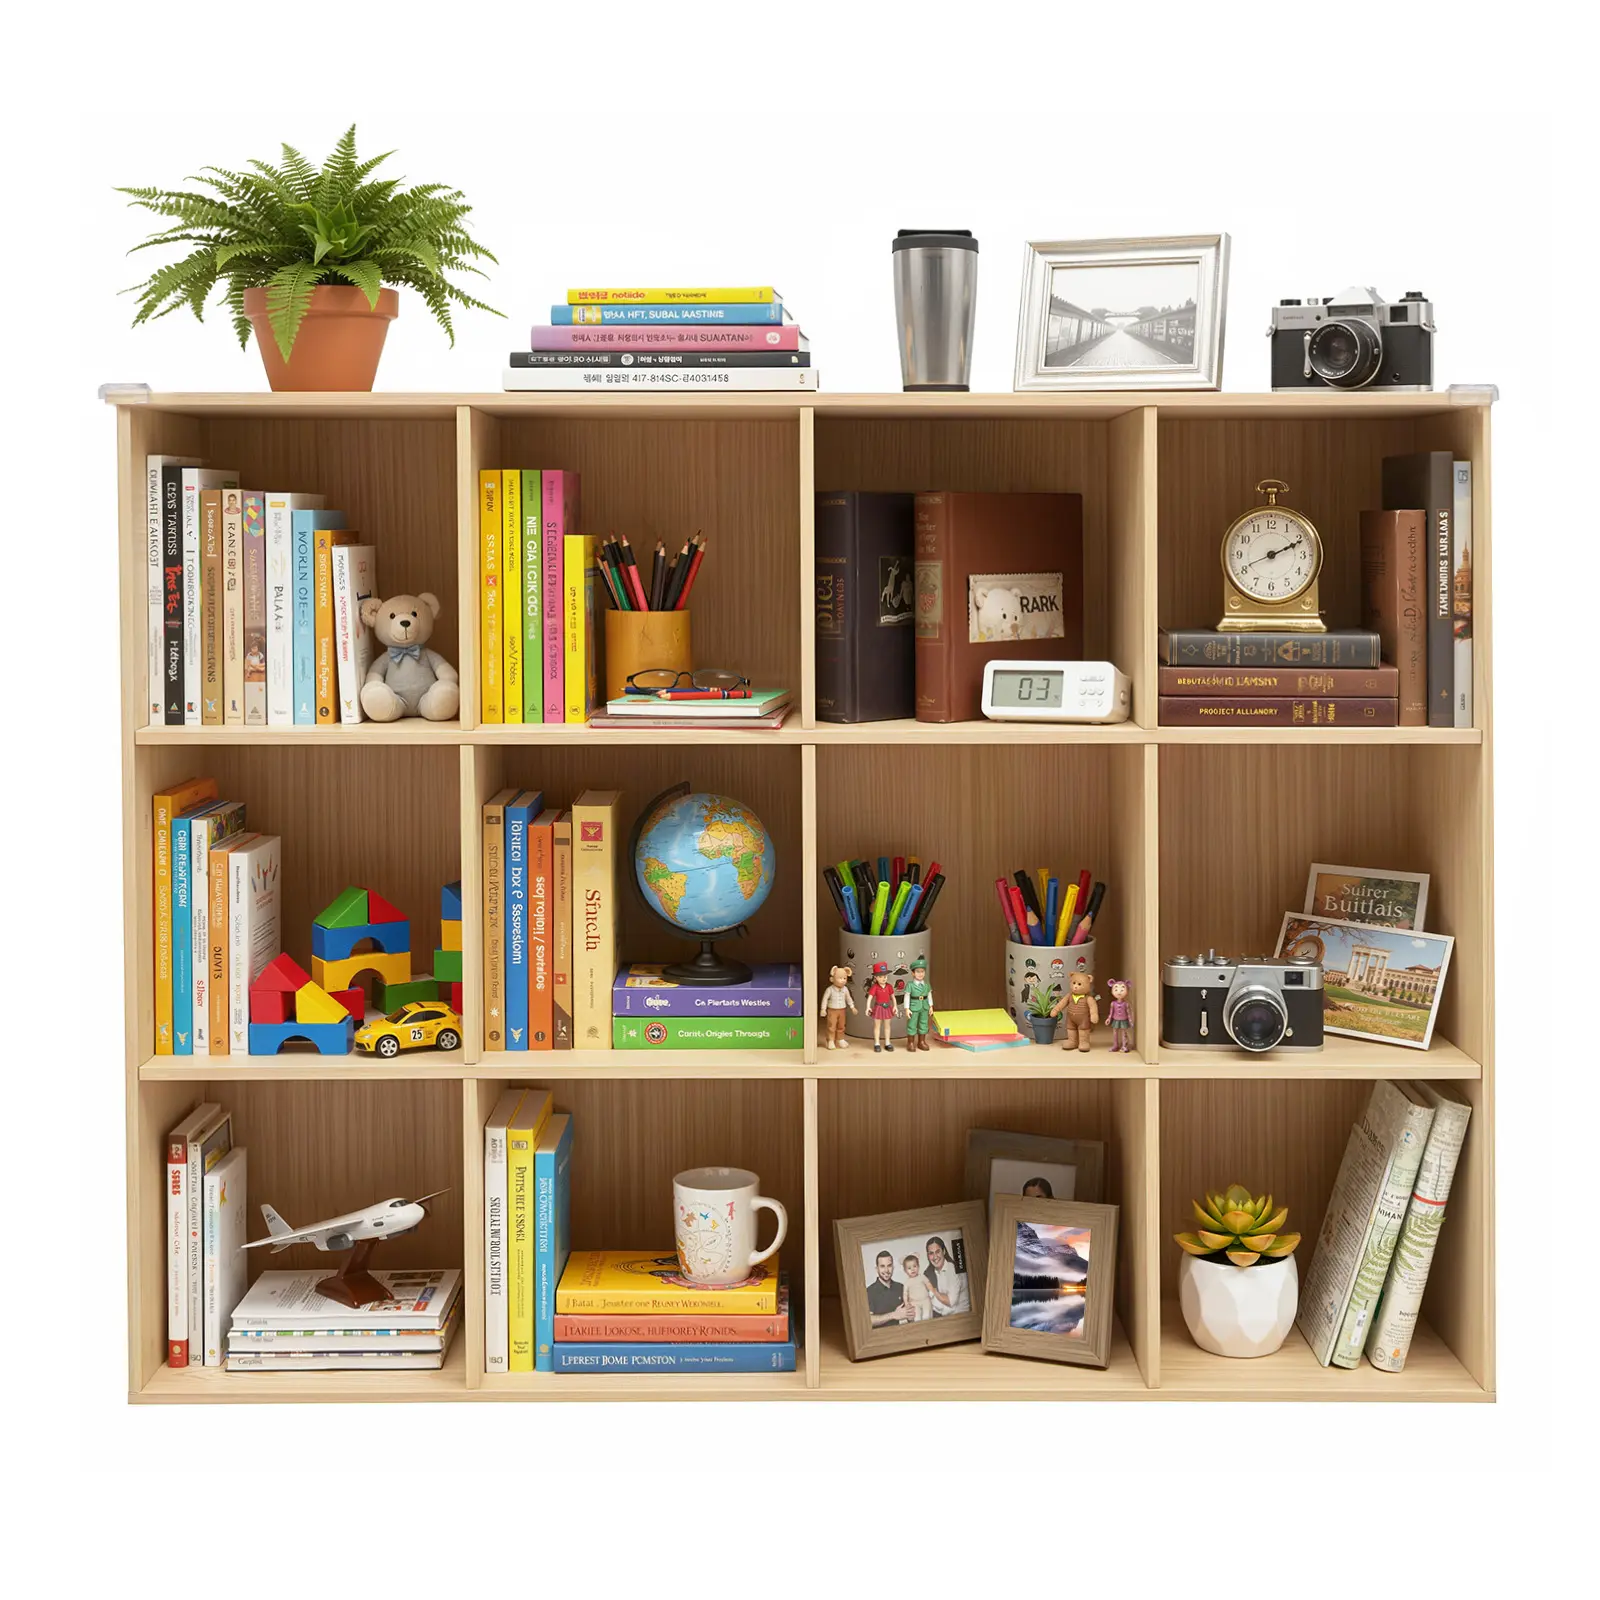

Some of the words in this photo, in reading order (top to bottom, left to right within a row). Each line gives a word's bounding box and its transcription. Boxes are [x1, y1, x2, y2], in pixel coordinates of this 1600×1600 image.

[1266, 520, 1277, 529] 12
[1284, 524, 1289, 533] 1
[1240, 535, 1250, 544] 10
[1236, 551, 1243, 559] 9
[1300, 551, 1306, 560] 3
[1241, 565, 1248, 575] 8
[1295, 567, 1301, 575] 4
[1253, 578, 1259, 587] 7
[1268, 582, 1275, 591] 6
[1284, 578, 1290, 587] 5
[1020, 595, 1059, 614] RARK
[412, 1030, 423, 1040] 25
